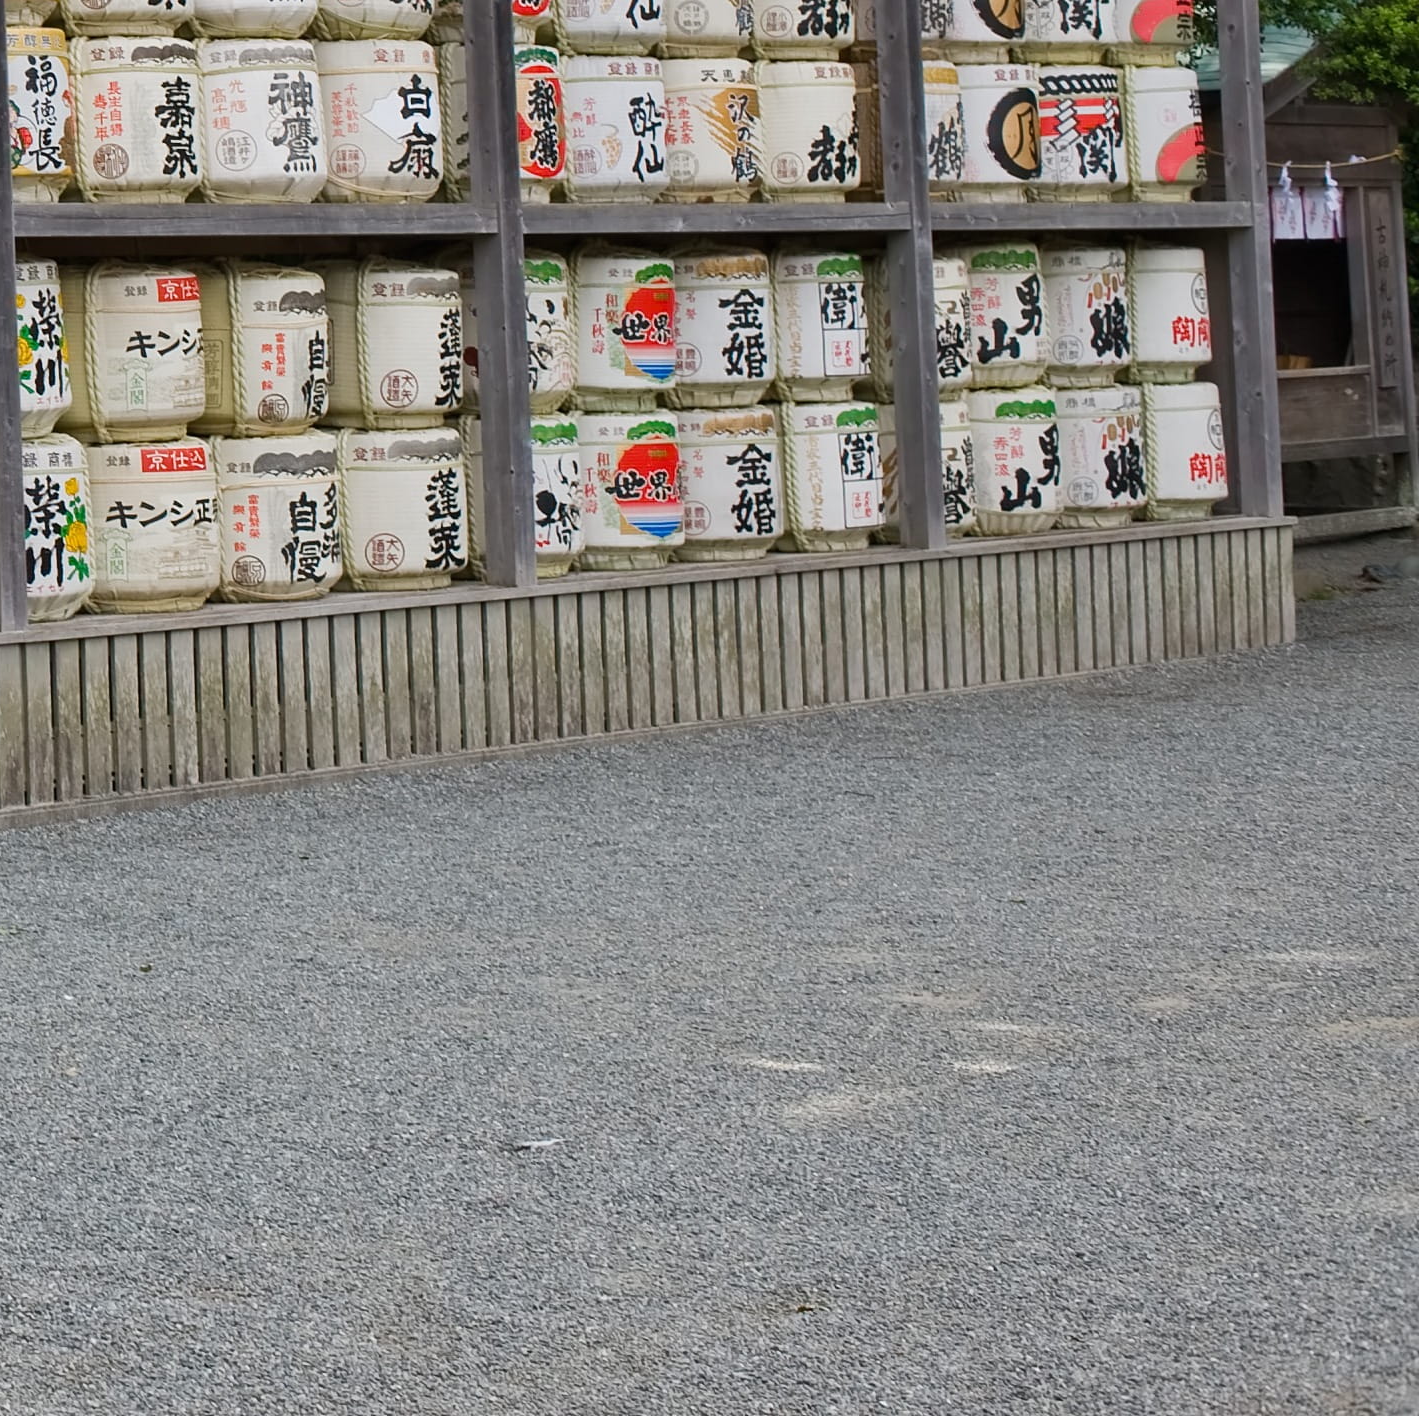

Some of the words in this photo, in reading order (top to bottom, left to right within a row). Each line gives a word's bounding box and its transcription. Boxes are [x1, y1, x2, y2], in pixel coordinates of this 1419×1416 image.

[25, 54, 63, 170] 福徳長
[155, 76, 198, 178] 嘉泉
[268, 72, 319, 173] 神鷹
[388, 74, 439, 179] 白扇
[726, 94, 759, 182] 沢の鶴
[719, 289, 767, 379] 金婚
[147, 451, 204, 471] 京仕込
[726, 444, 776, 535] 金婚
